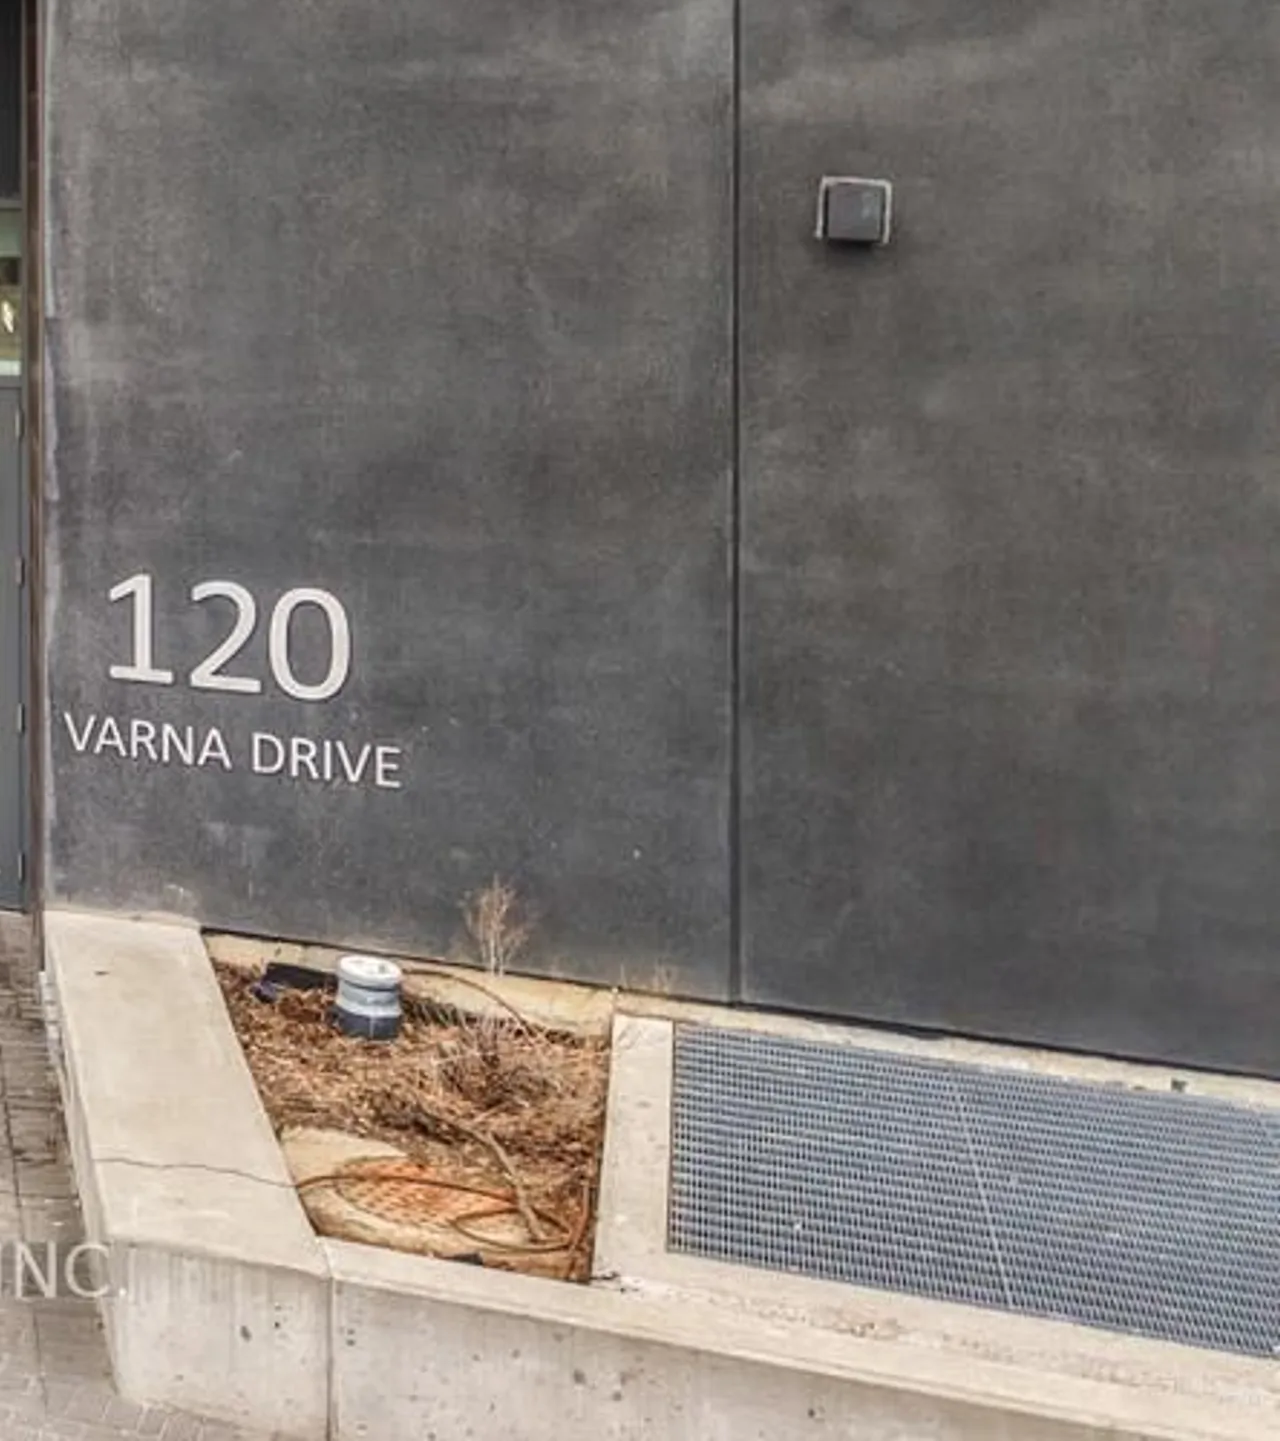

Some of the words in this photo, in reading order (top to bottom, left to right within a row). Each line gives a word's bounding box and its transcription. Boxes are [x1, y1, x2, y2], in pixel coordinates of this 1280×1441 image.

[108, 572, 352, 701] 120
[63, 711, 232, 771] VARNA
[251, 732, 403, 789] DRIVE
